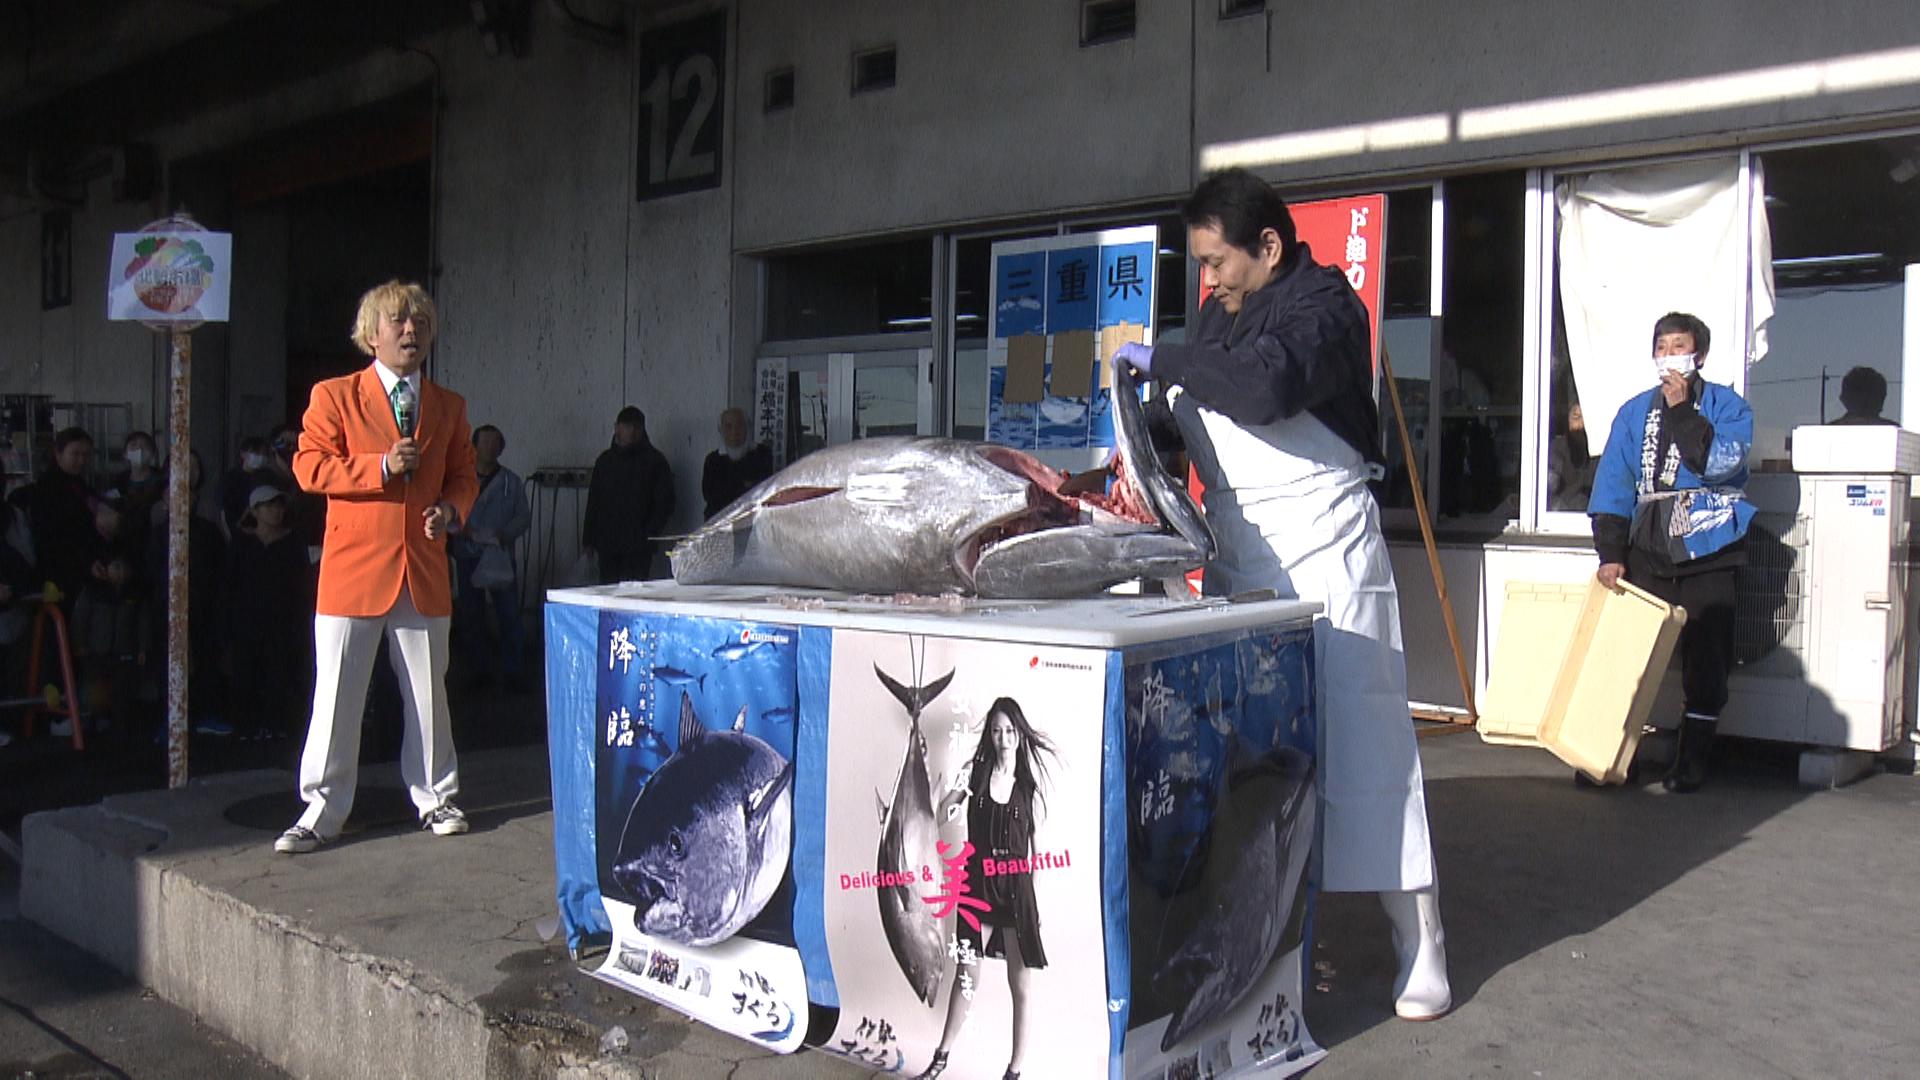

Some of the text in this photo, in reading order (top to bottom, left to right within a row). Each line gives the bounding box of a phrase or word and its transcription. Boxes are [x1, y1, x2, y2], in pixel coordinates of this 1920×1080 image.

[641, 53, 718, 184] 12
[1007, 255, 1144, 304] 三重県
[1345, 207, 1369, 290] ド迫力
[607, 627, 637, 747] 降臨
[1141, 668, 1175, 826] 降臨
[840, 849, 1071, 890] Delicious & Beautiful
[922, 840, 992, 932] 美
